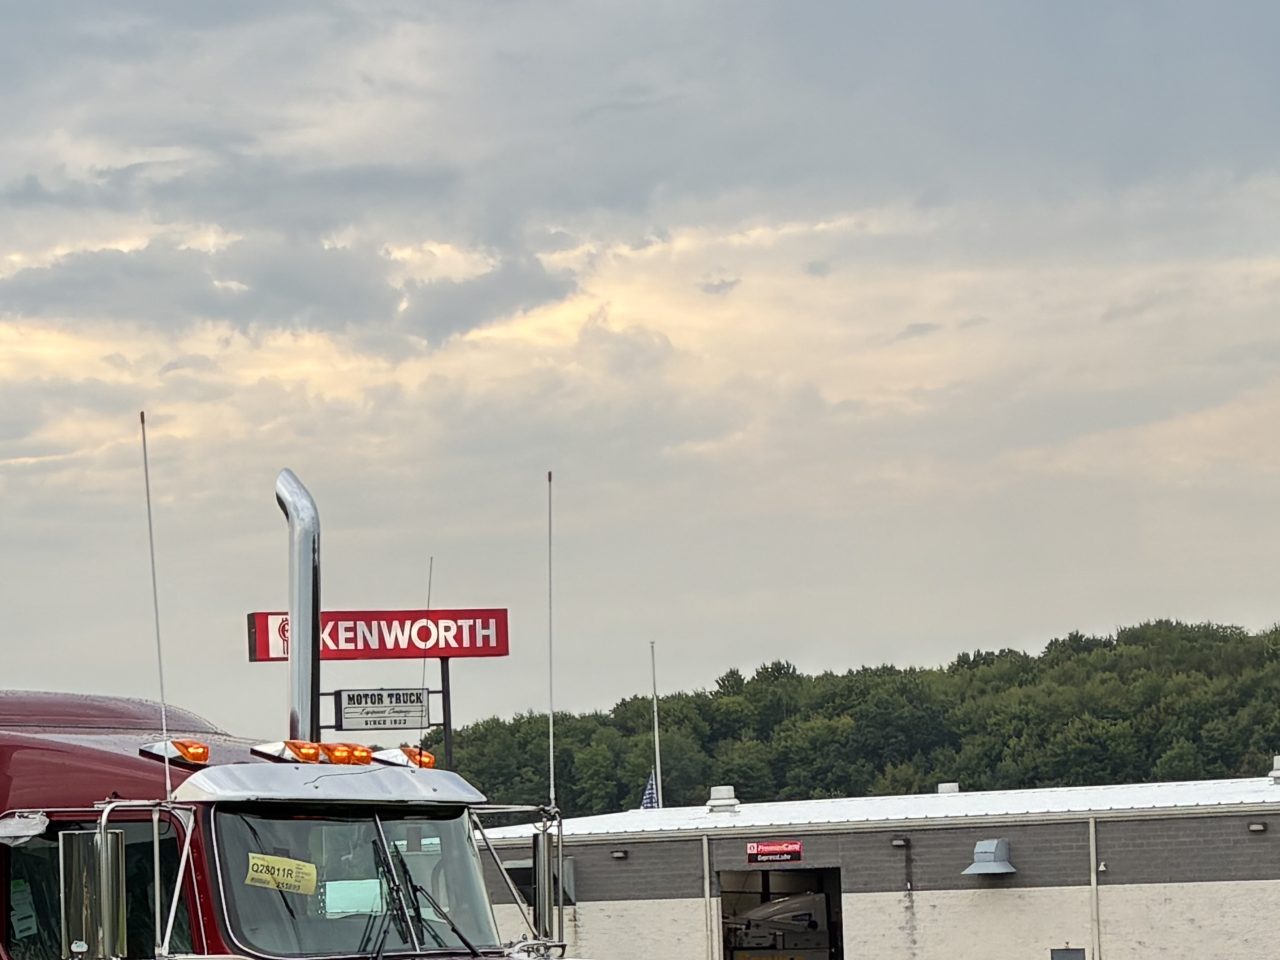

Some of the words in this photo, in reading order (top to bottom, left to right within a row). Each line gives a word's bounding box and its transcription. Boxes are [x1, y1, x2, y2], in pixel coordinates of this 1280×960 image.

[320, 618, 497, 650] KENWORTH
[347, 693, 384, 705] MOTOR
[388, 692, 423, 704] TRUCK
[251, 863, 294, 878] Q28011R
